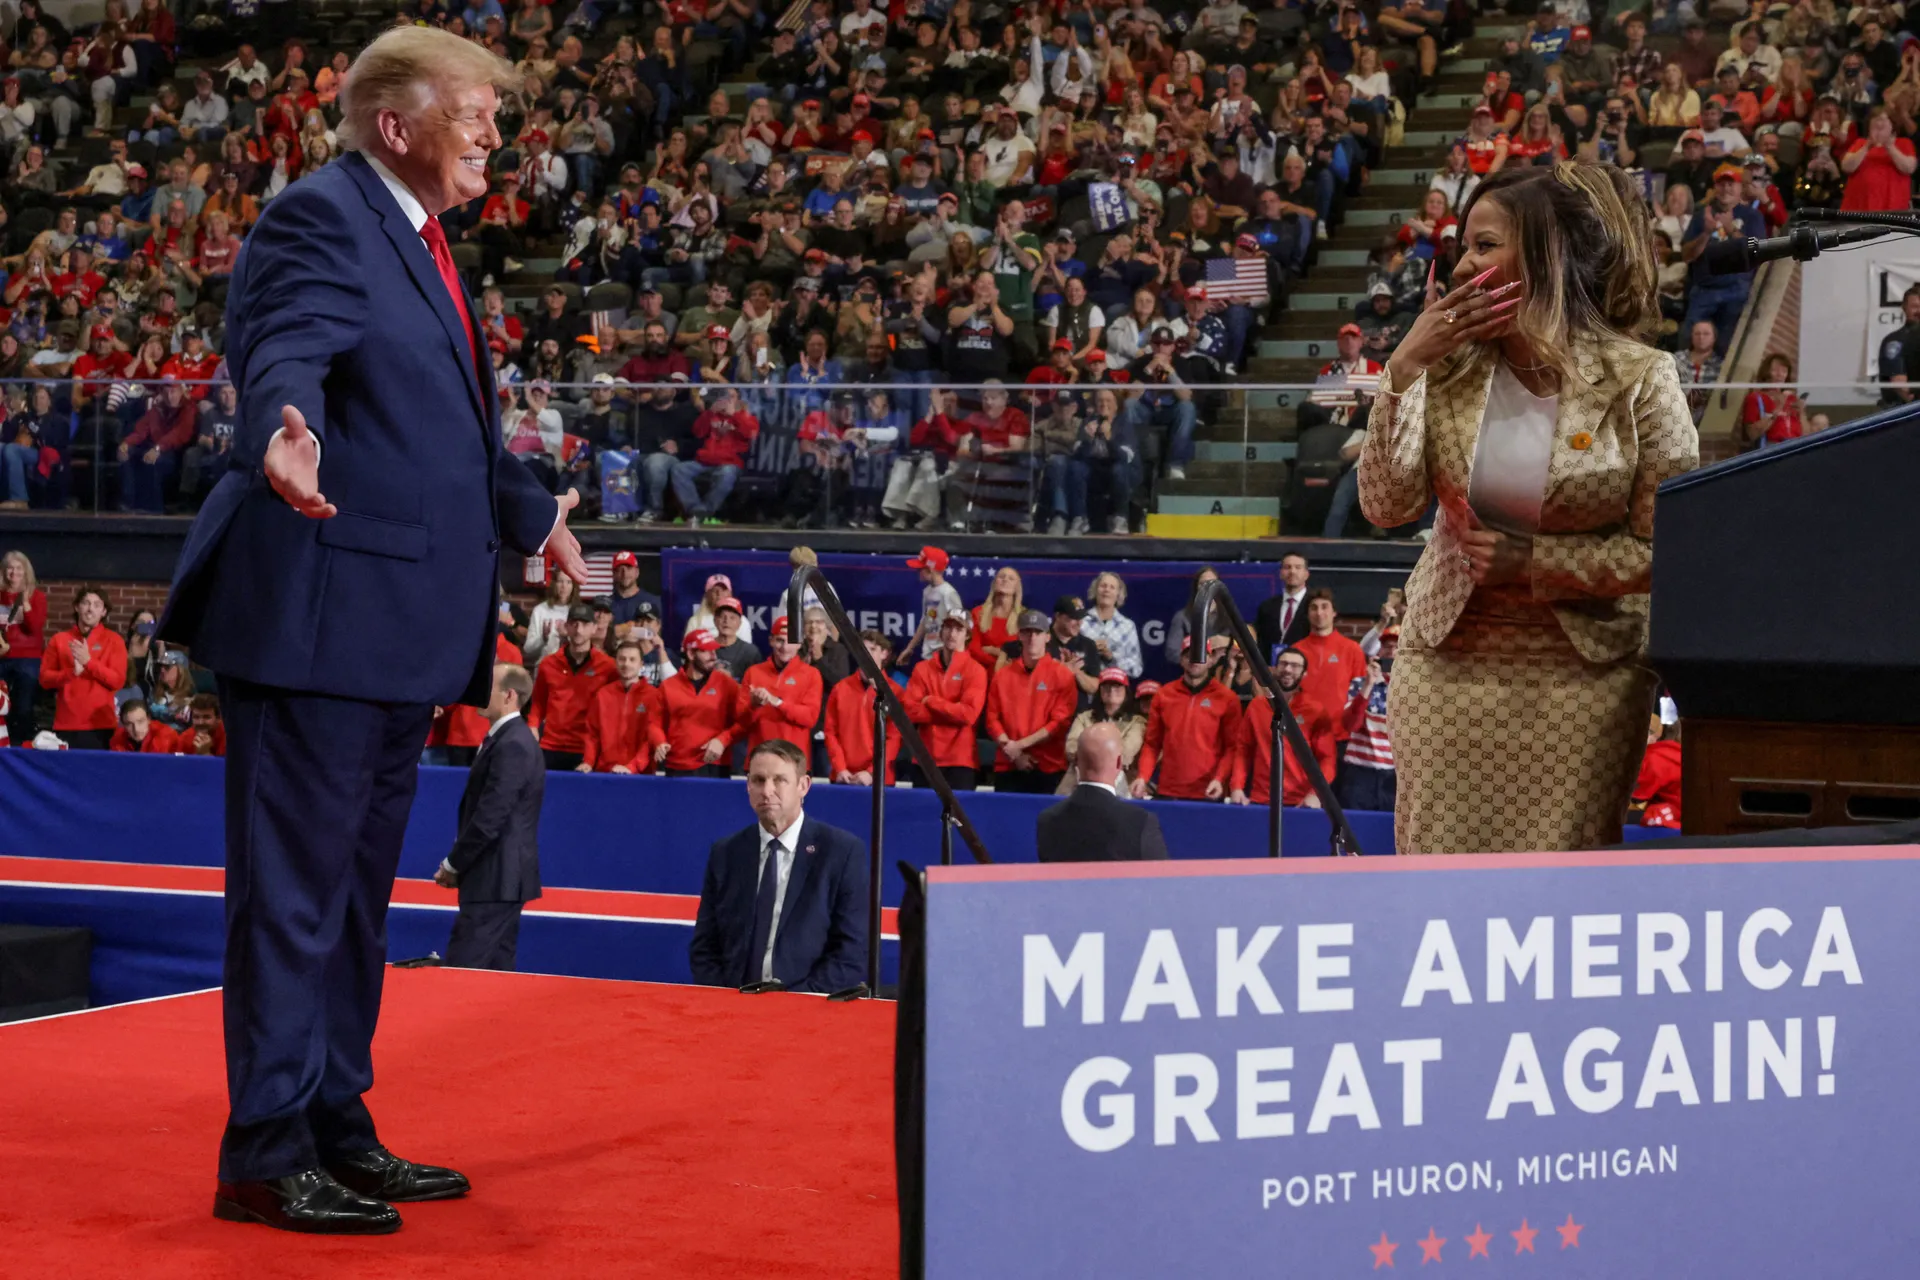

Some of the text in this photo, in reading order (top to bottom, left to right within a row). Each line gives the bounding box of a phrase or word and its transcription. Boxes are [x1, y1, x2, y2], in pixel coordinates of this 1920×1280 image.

[1337, 296, 1349, 310] E
[1308, 343, 1320, 357] D
[1276, 394, 1290, 408] C
[1245, 446, 1257, 461] B
[1210, 500, 1223, 515] A
[1021, 905, 1865, 1028] MAKE AMERICA
[1060, 1014, 1837, 1152] GREAT AGAIN!
[1262, 1144, 1678, 1209] PORT HURON, MICHIGAN
